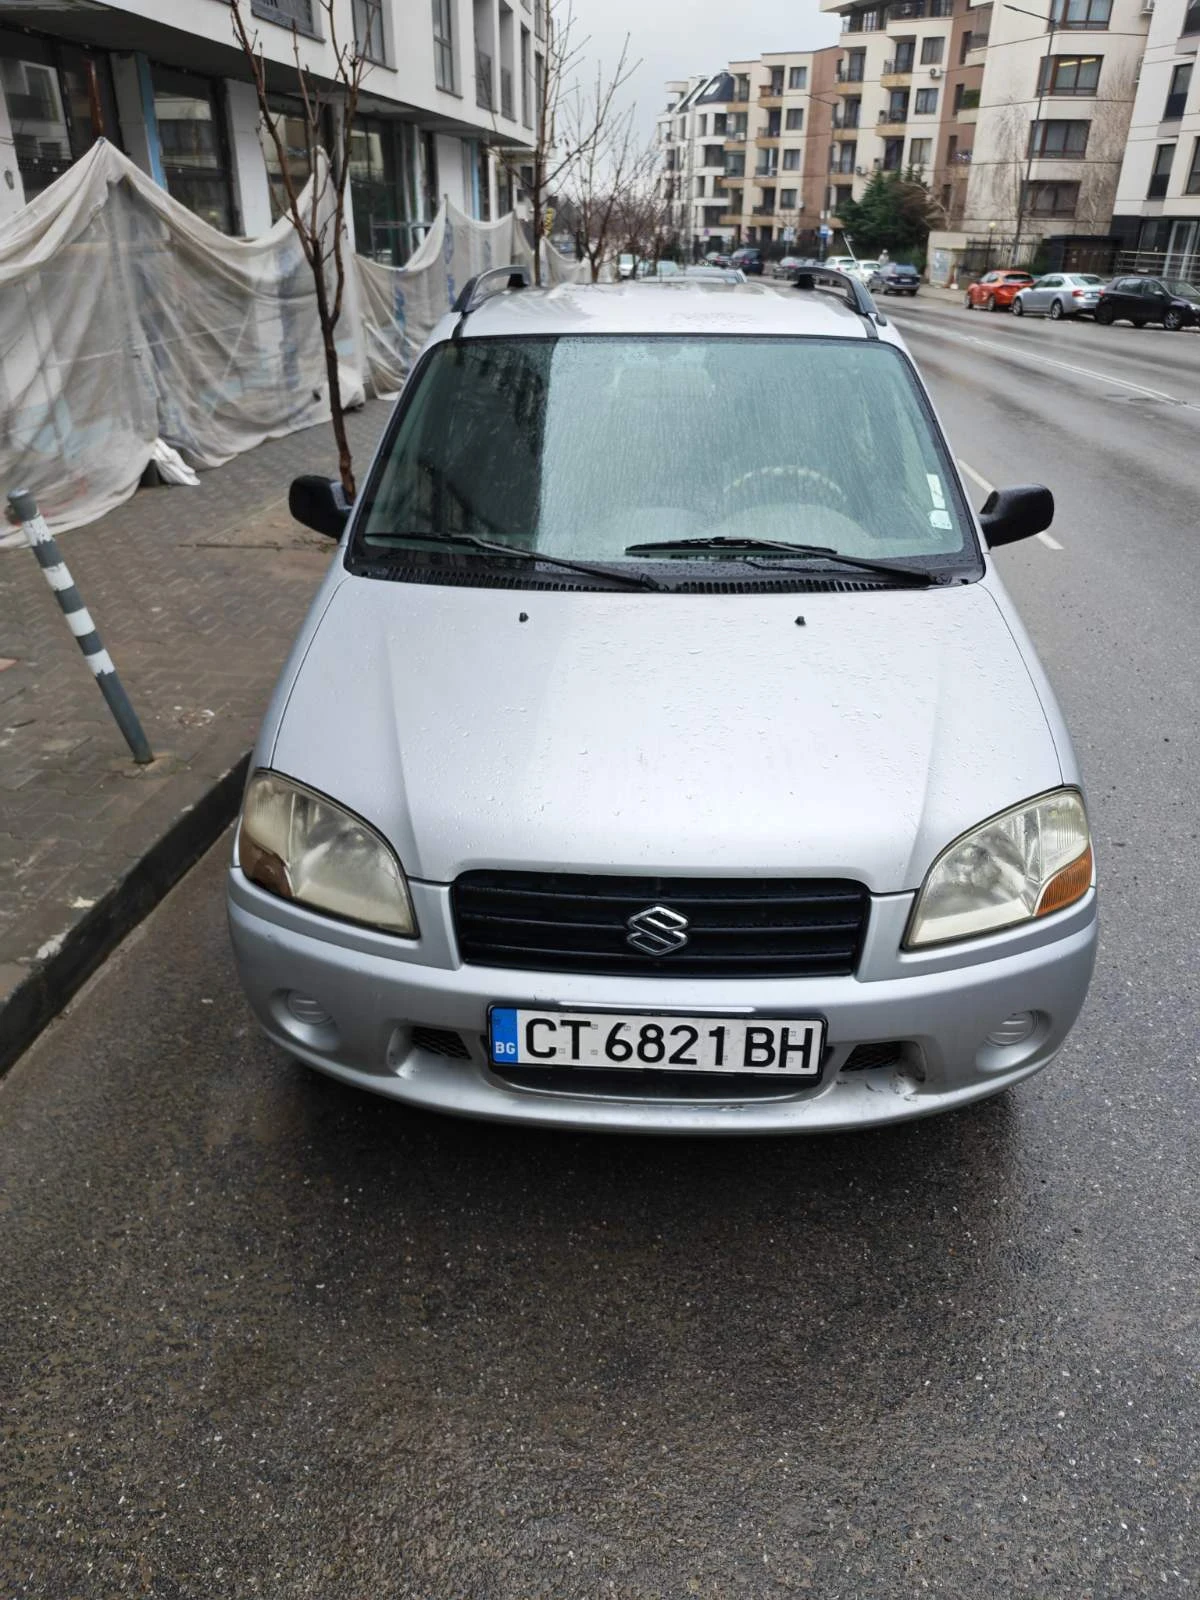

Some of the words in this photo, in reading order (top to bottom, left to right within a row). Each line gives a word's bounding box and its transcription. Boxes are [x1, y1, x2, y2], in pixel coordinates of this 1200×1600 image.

[495, 1041, 516, 1055] BG
[525, 1018, 592, 1060] CT
[604, 1022, 726, 1066] 6821
[743, 1026, 814, 1069] BH
